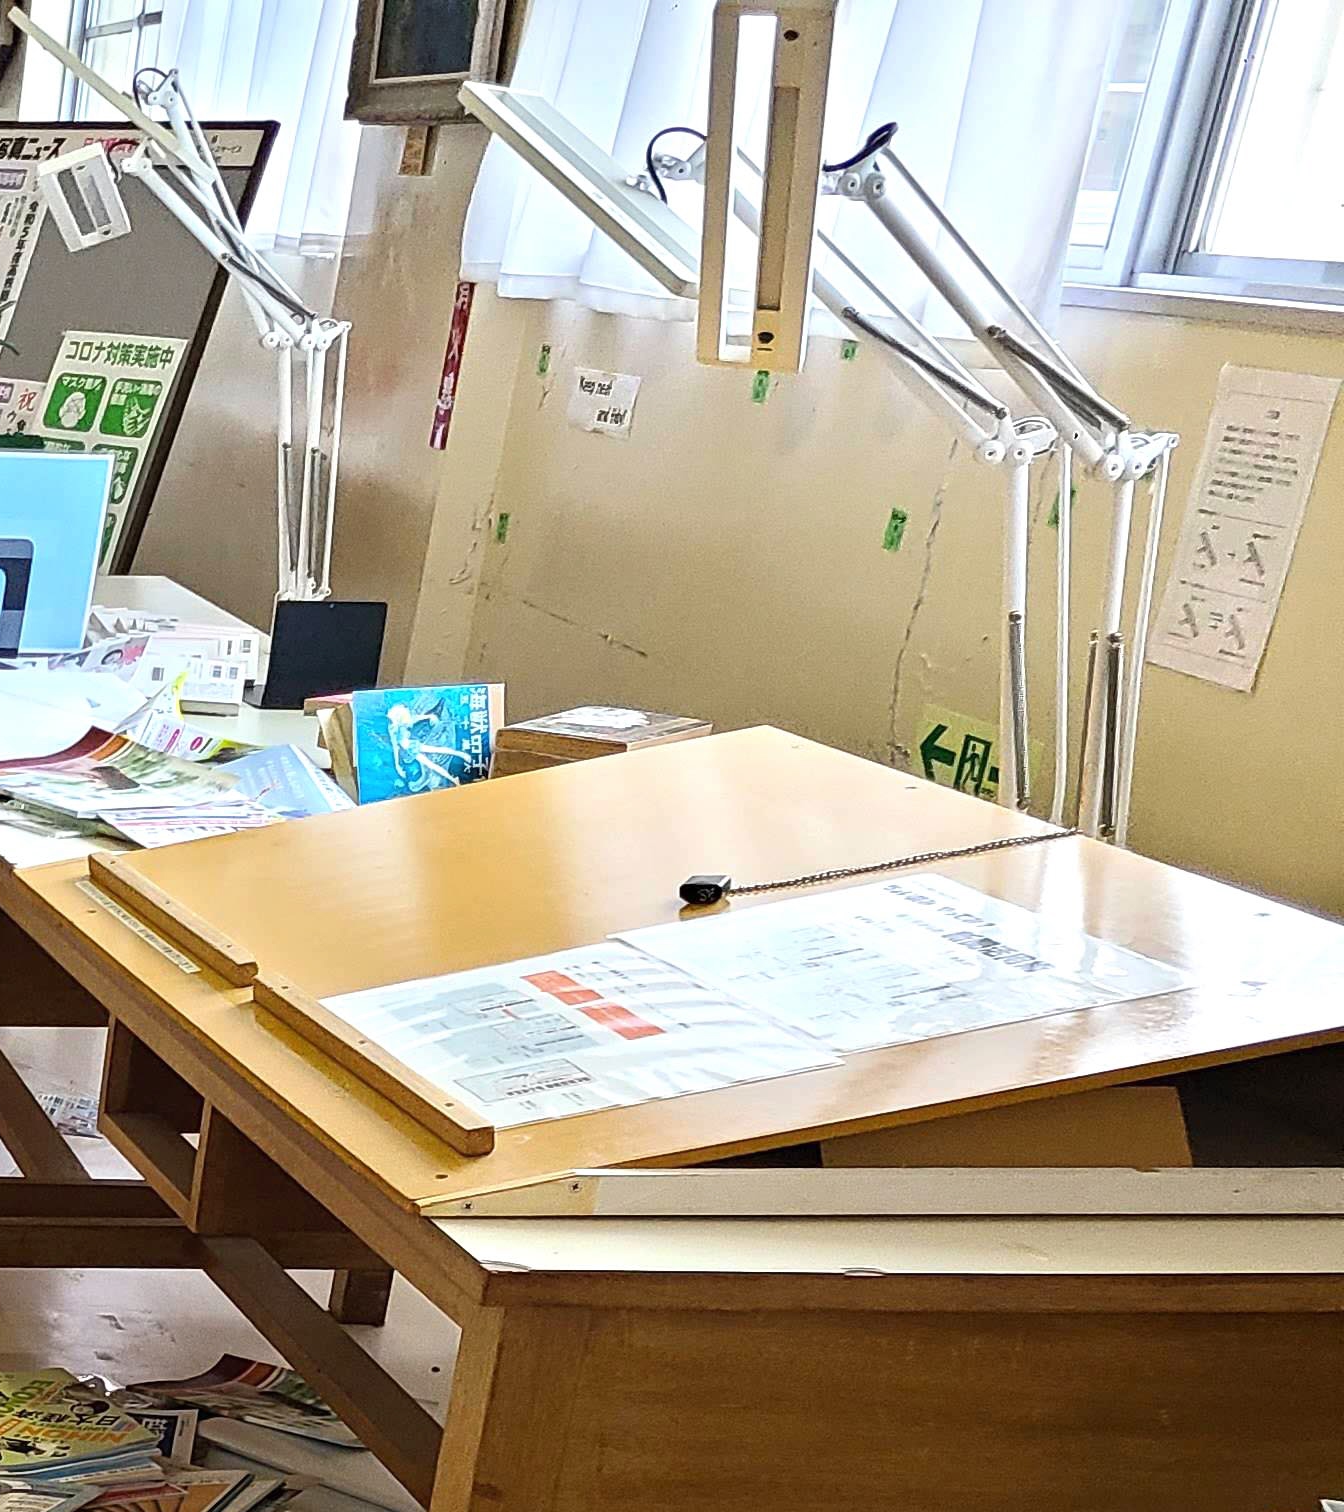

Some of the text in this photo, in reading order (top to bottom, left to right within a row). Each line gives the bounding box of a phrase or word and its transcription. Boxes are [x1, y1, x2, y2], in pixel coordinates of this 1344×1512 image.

[65, 341, 175, 371] コロナ対策実施中
[18, 388, 37, 412] 祝
